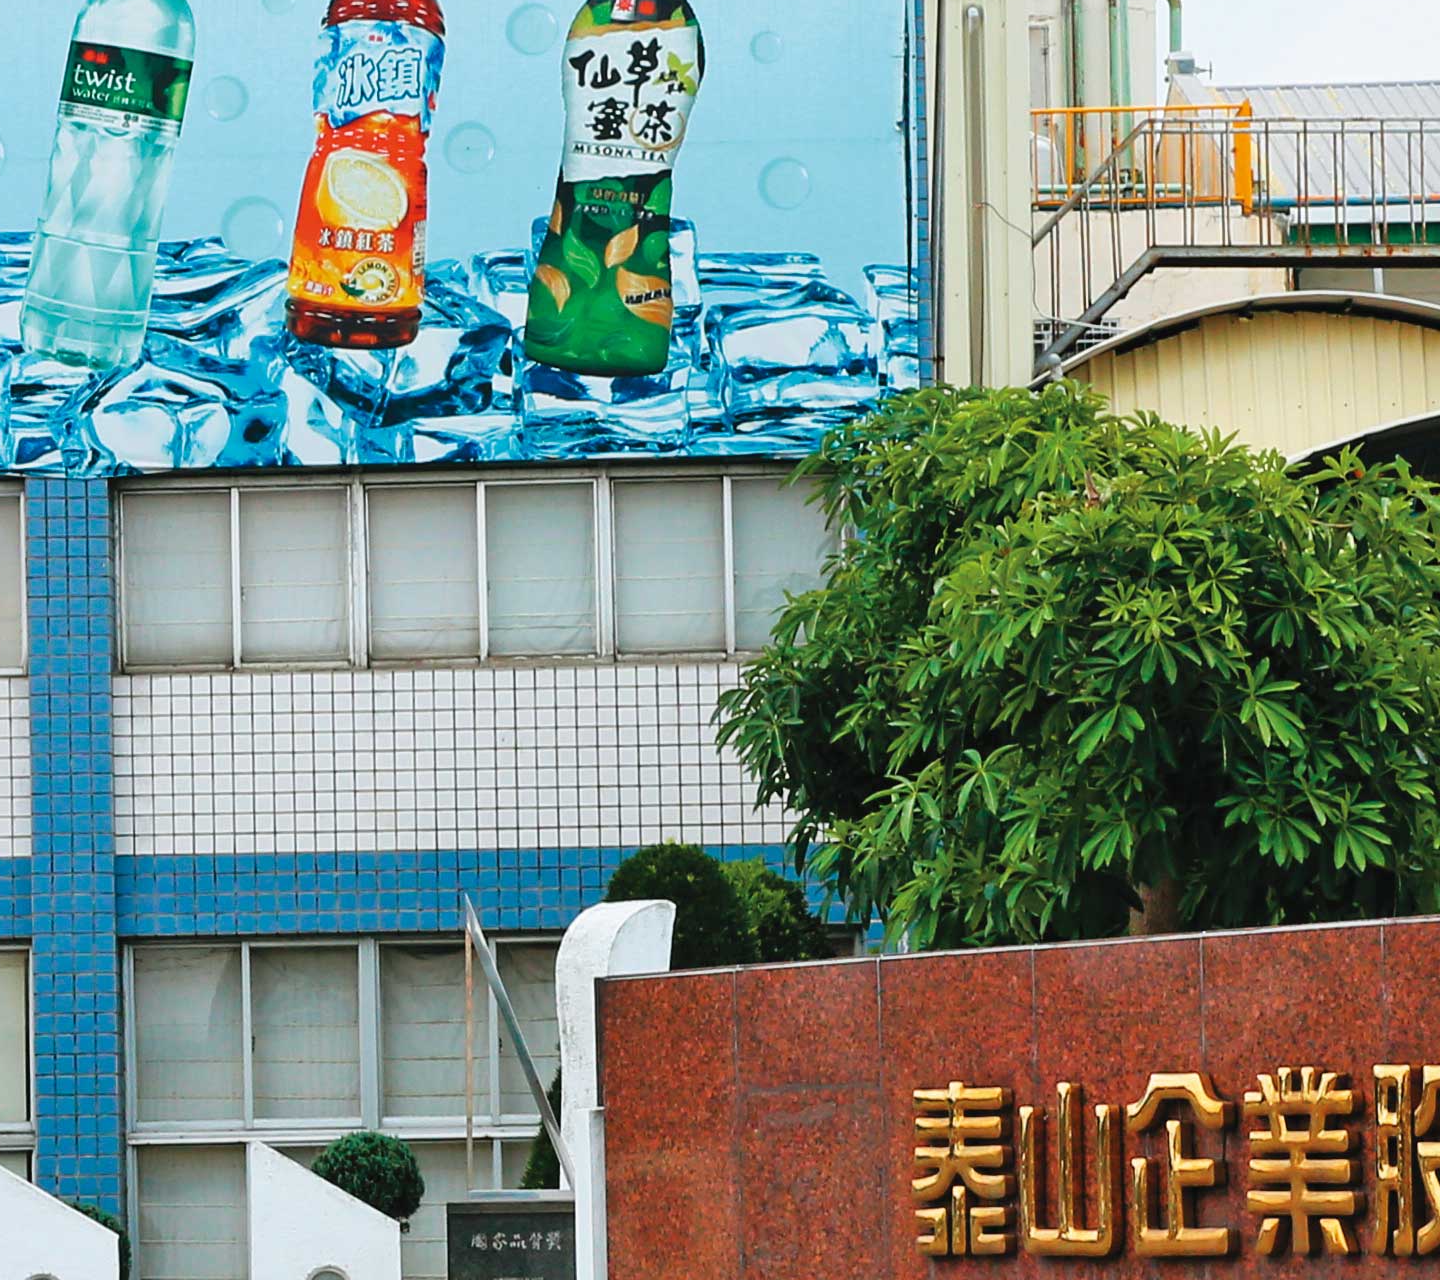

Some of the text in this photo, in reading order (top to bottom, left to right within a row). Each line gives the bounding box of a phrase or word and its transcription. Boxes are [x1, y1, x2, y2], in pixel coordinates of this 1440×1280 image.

[74, 63, 137, 94] twist
[336, 47, 422, 109] 冰鎮
[72, 87, 110, 101] water
[572, 143, 668, 163] MISONA TEA
[318, 227, 395, 253] 冰鎮紅茶
